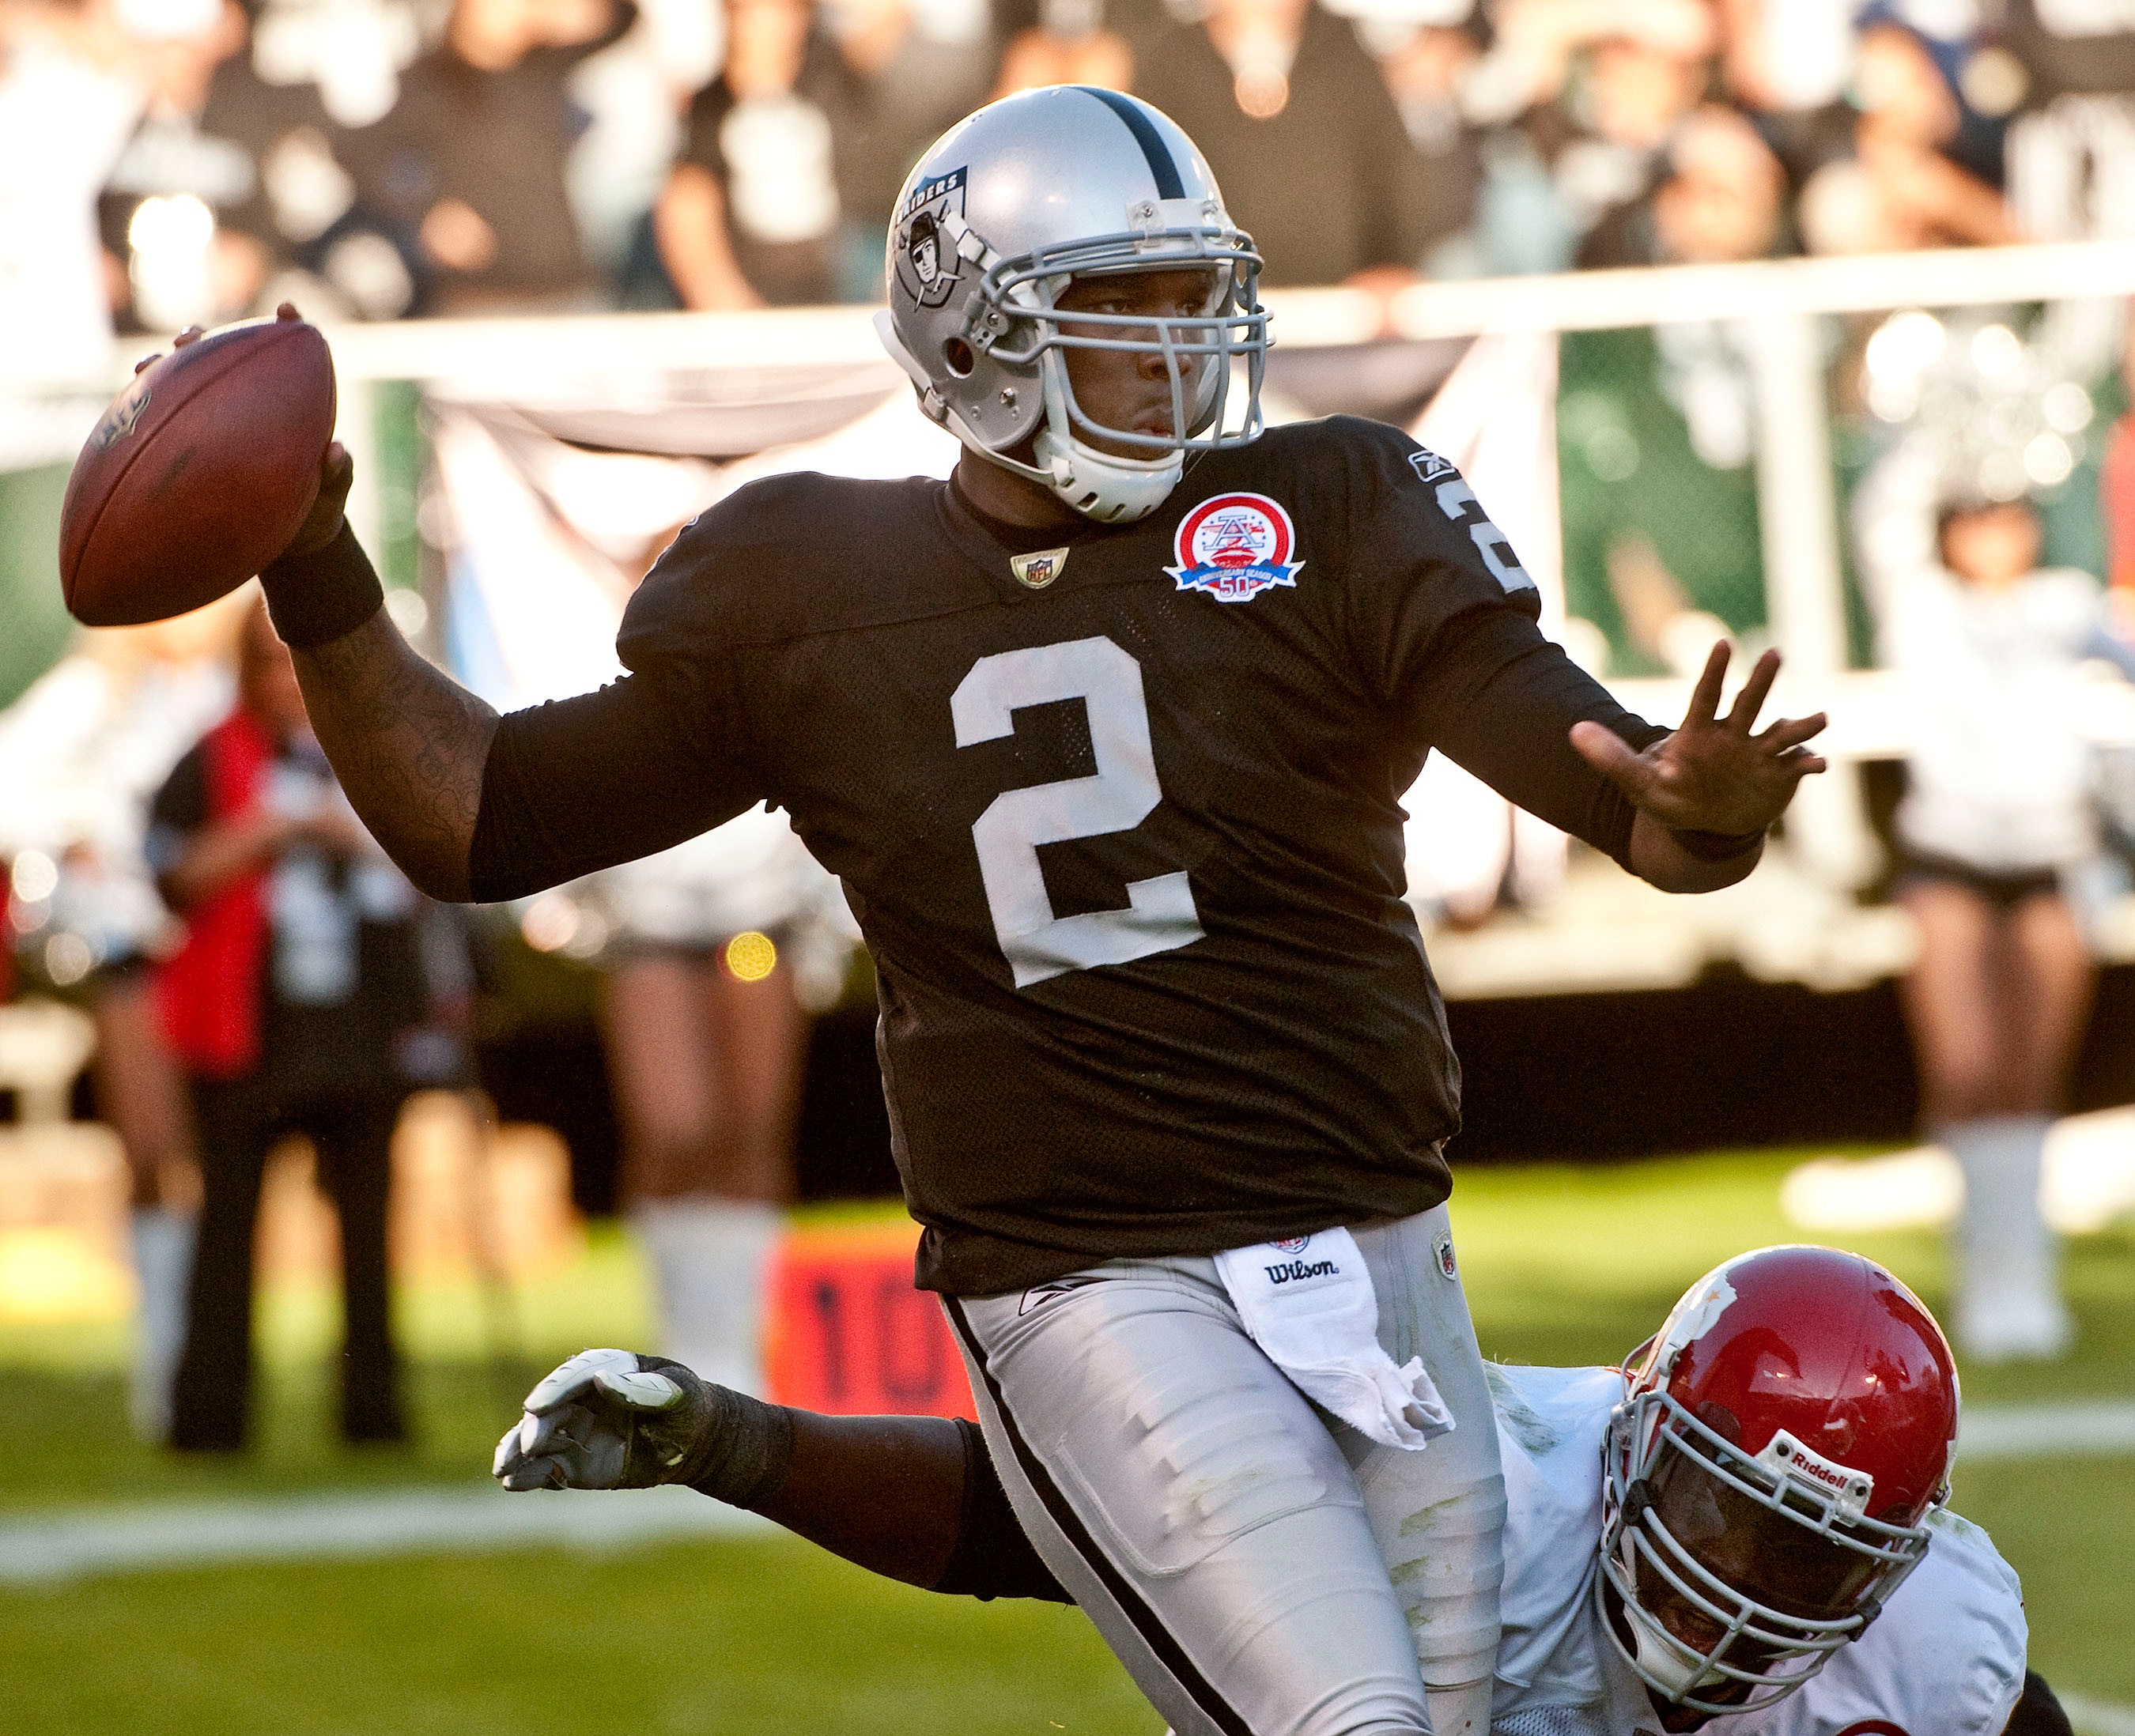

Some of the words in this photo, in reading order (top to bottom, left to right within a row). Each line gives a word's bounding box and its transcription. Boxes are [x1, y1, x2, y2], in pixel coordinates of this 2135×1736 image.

[1219, 576, 1250, 598] 50
[950, 636, 1207, 989] 2
[1264, 1260, 1336, 1284] Wilson
[813, 1274, 947, 1408] 10
[1792, 1452, 1849, 1489] Riddell
